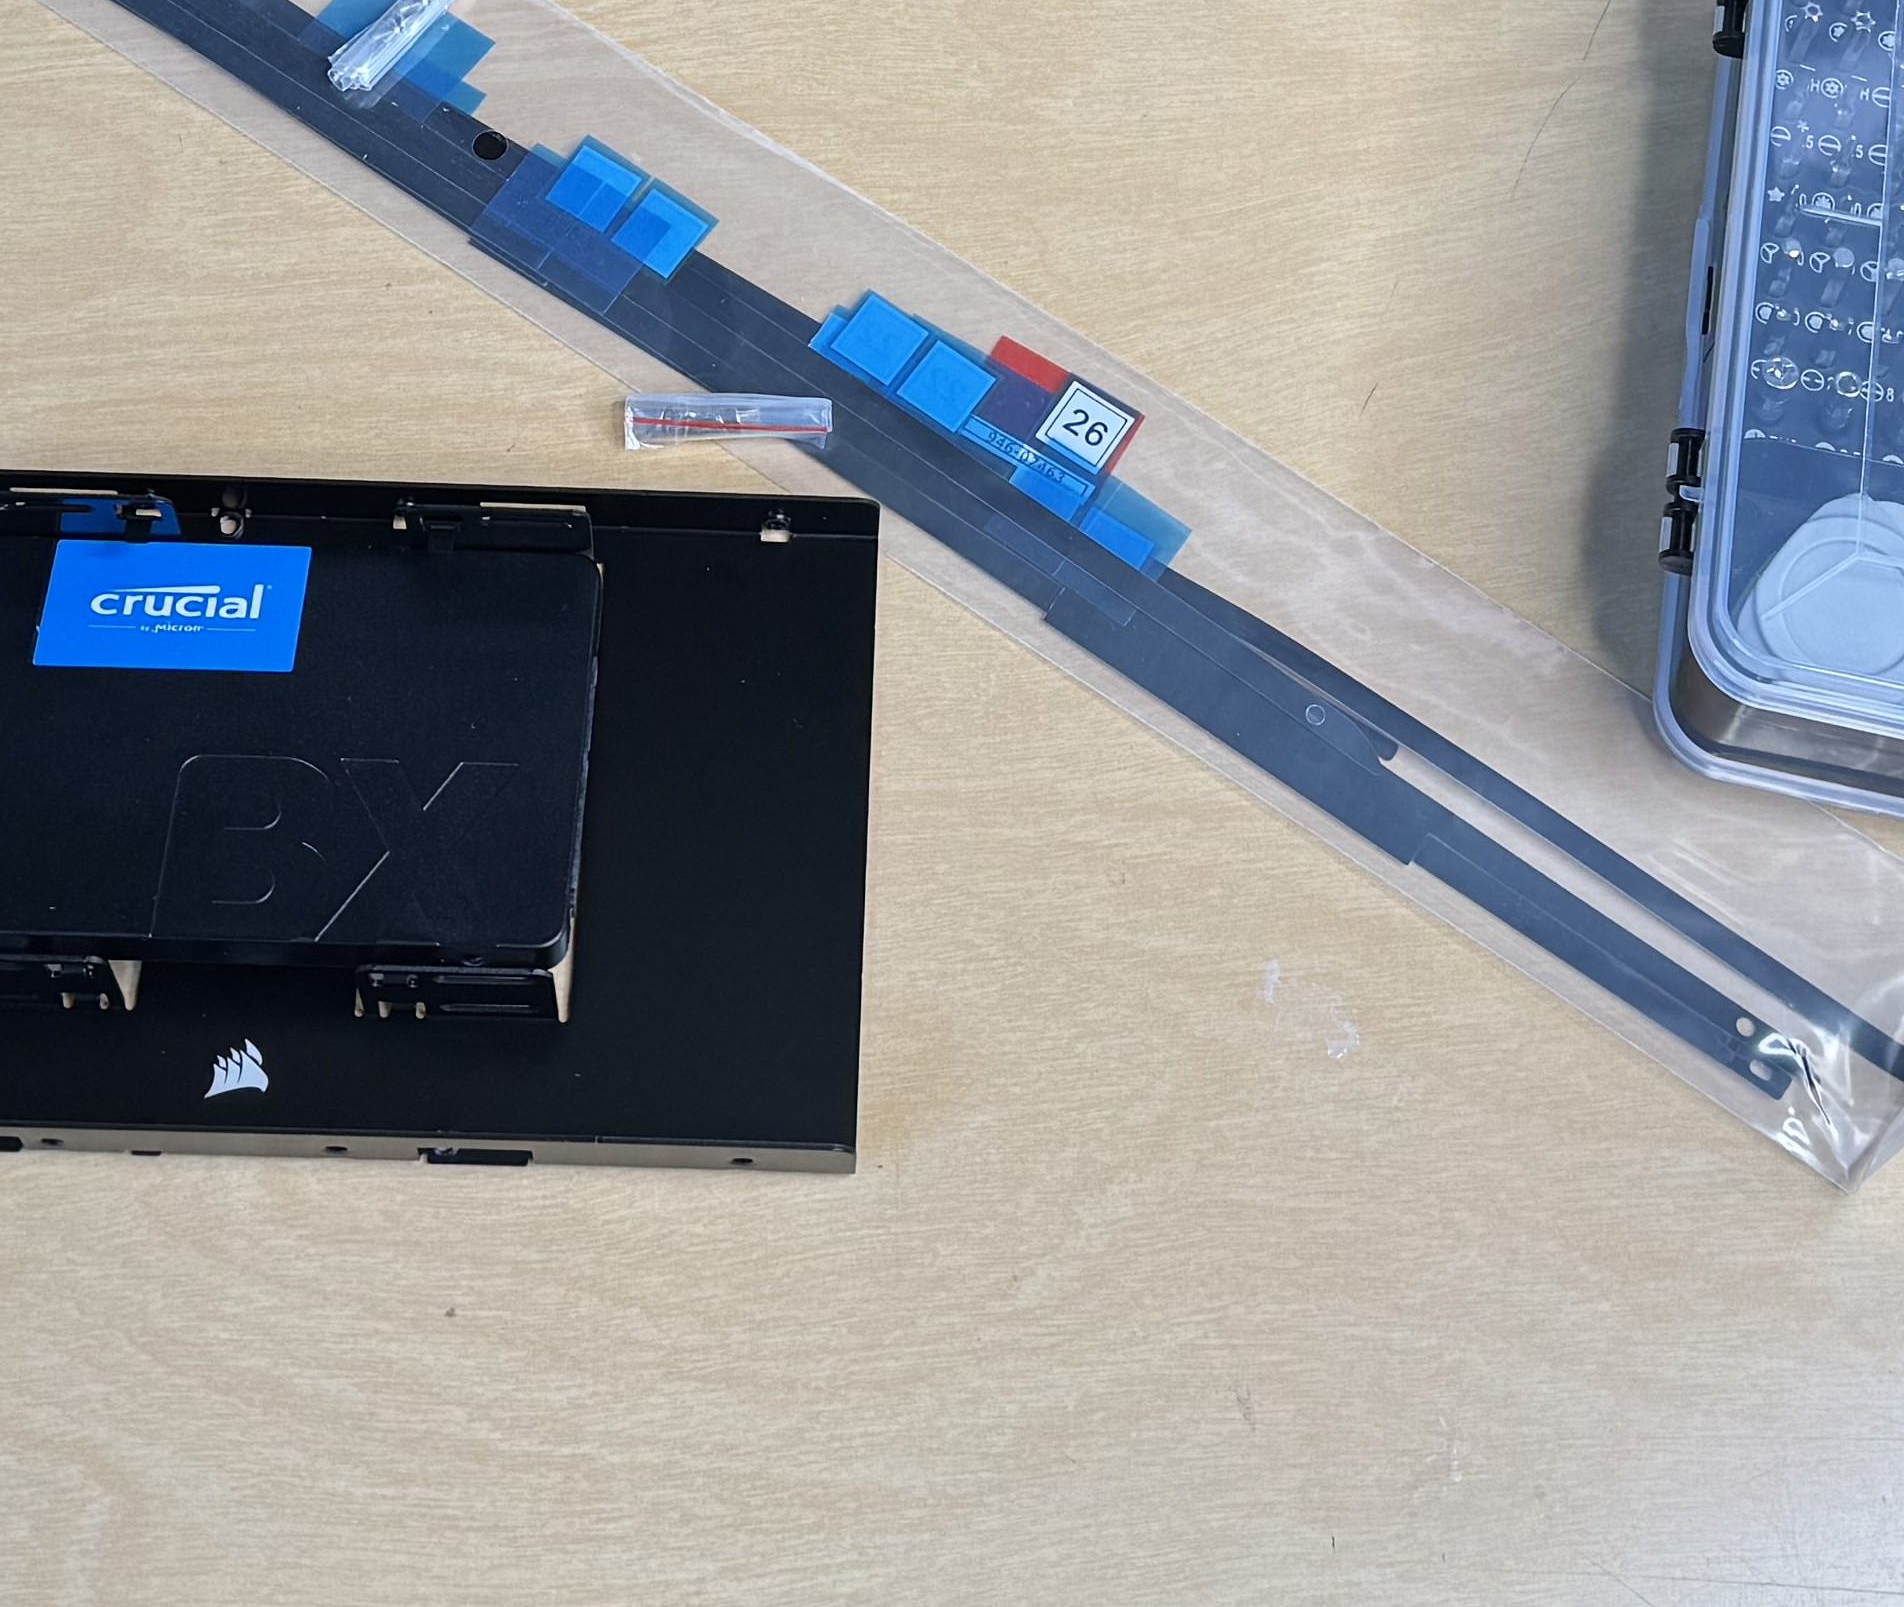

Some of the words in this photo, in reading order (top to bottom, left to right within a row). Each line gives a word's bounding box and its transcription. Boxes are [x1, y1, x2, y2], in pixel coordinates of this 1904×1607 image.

[1062, 409, 1109, 446] 26
[90, 584, 264, 619] crucial
[149, 754, 520, 946] BX
